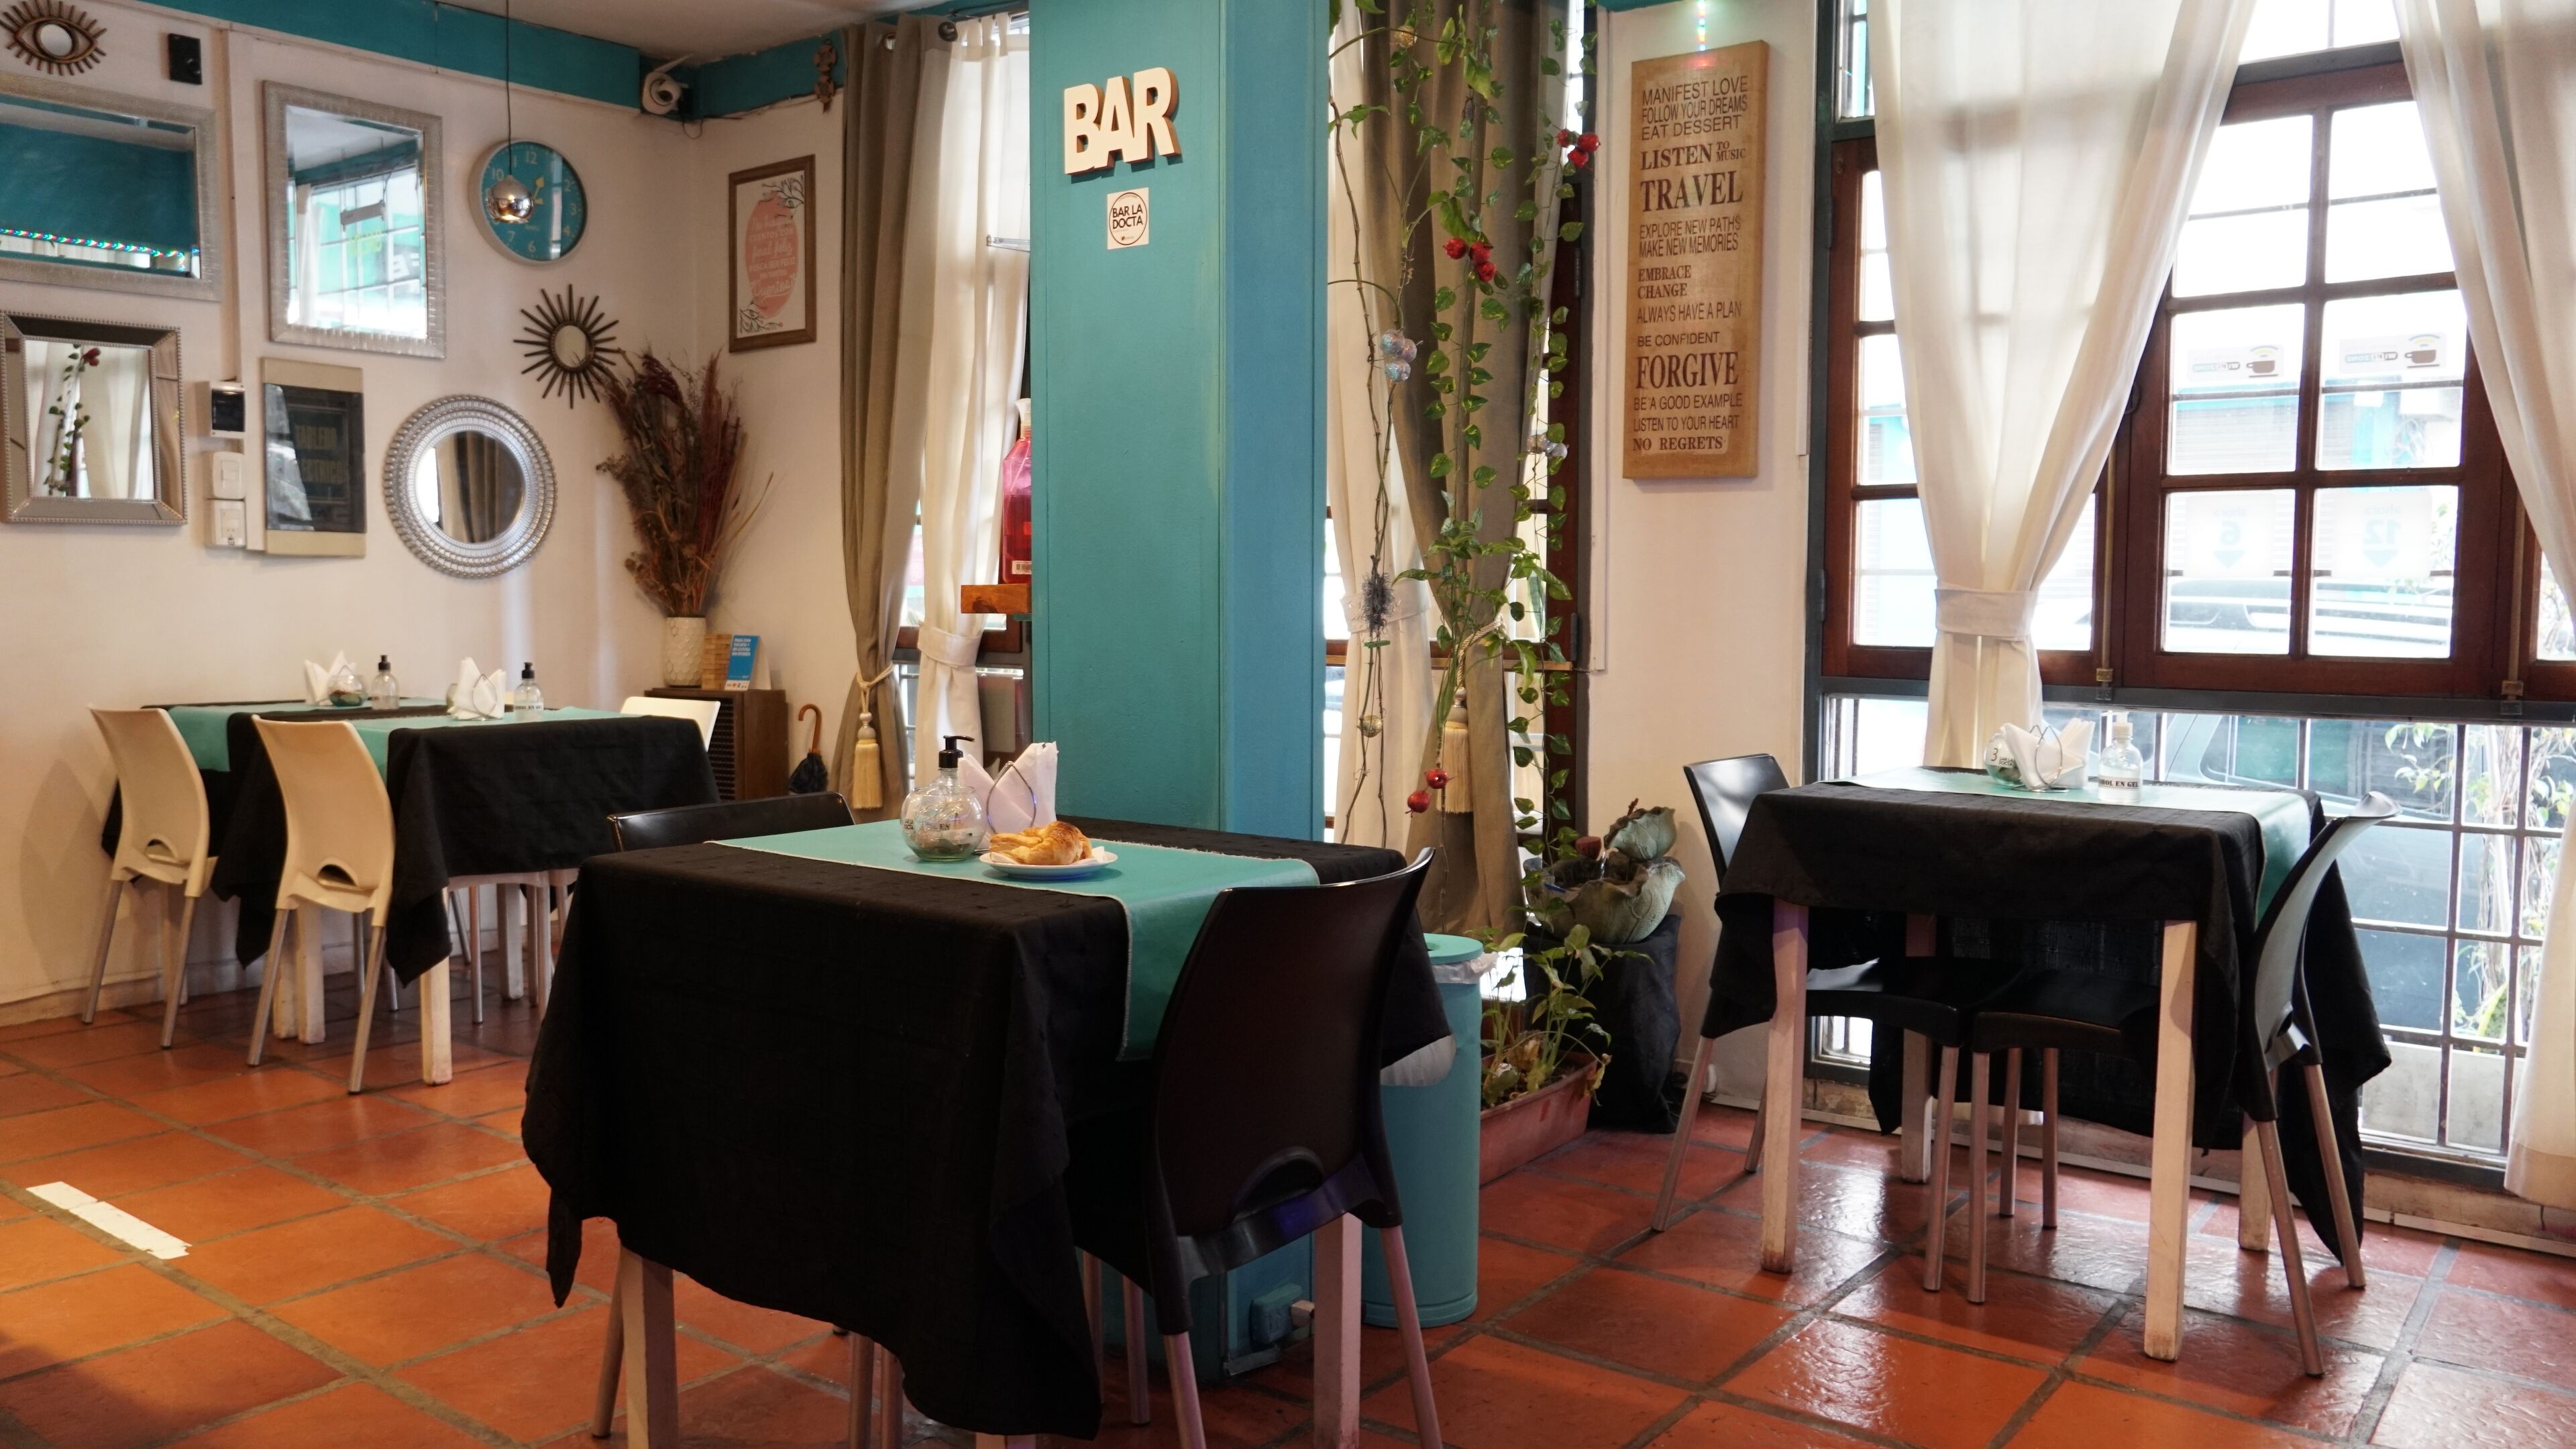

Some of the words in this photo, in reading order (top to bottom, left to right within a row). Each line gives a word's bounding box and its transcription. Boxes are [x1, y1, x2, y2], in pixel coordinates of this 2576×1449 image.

[1643, 81, 1709, 105] MANIFEST
[1713, 76, 1748, 95] LOVE
[1642, 103, 1679, 123] FOLLOW
[1682, 100, 1706, 119] YOUR
[1709, 95, 1747, 115] DREAMS
[1064, 67, 1179, 176] BAR
[1642, 123, 1668, 140] EAT
[1674, 115, 1741, 137] DESSERT
[1717, 141, 1729, 150] TO
[526, 152, 537, 164] 12
[1641, 144, 1713, 170] LISTEN
[1716, 148, 1746, 162] MUSIC
[492, 168, 504, 181] 10
[1640, 170, 1744, 212] TRAVEL
[1112, 205, 1130, 218] BAR
[1132, 204, 1143, 215] LA
[1112, 215, 1143, 229] DOCTA
[1640, 219, 1682, 239] EXPLORE
[1685, 219, 1707, 235] NEW
[1711, 215, 1741, 233] PATHS
[508, 231, 516, 242] 7
[1640, 239, 1664, 258] MAKE
[1666, 237, 1686, 256] NEW
[1690, 233, 1739, 254] MEMORIES
[1638, 265, 1691, 282] EMBRACE
[1638, 283, 1688, 299] CHANGE
[1637, 305, 1676, 323] ALWAYS
[1679, 303, 1705, 321] HAVE
[1707, 302, 1713, 319] A
[1716, 301, 1741, 319] PLAN
[1638, 335, 1652, 347] BE
[1655, 331, 1720, 346] CONFIDENT
[1636, 351, 1739, 389] FORGIVE
[1634, 397, 1646, 411] BE
[1650, 396, 1656, 409] A
[1660, 395, 1690, 409] GOOD
[1694, 393, 1743, 409] EXAMPLE
[1633, 417, 1664, 432] LISTEN
[1666, 417, 1678, 431] TO
[1681, 416, 1706, 430] YOUR
[1709, 415, 1739, 430] HEART
[1633, 437, 1652, 451] NO
[1660, 436, 1723, 450] REGRETS
[1991, 747, 1998, 761] 3
